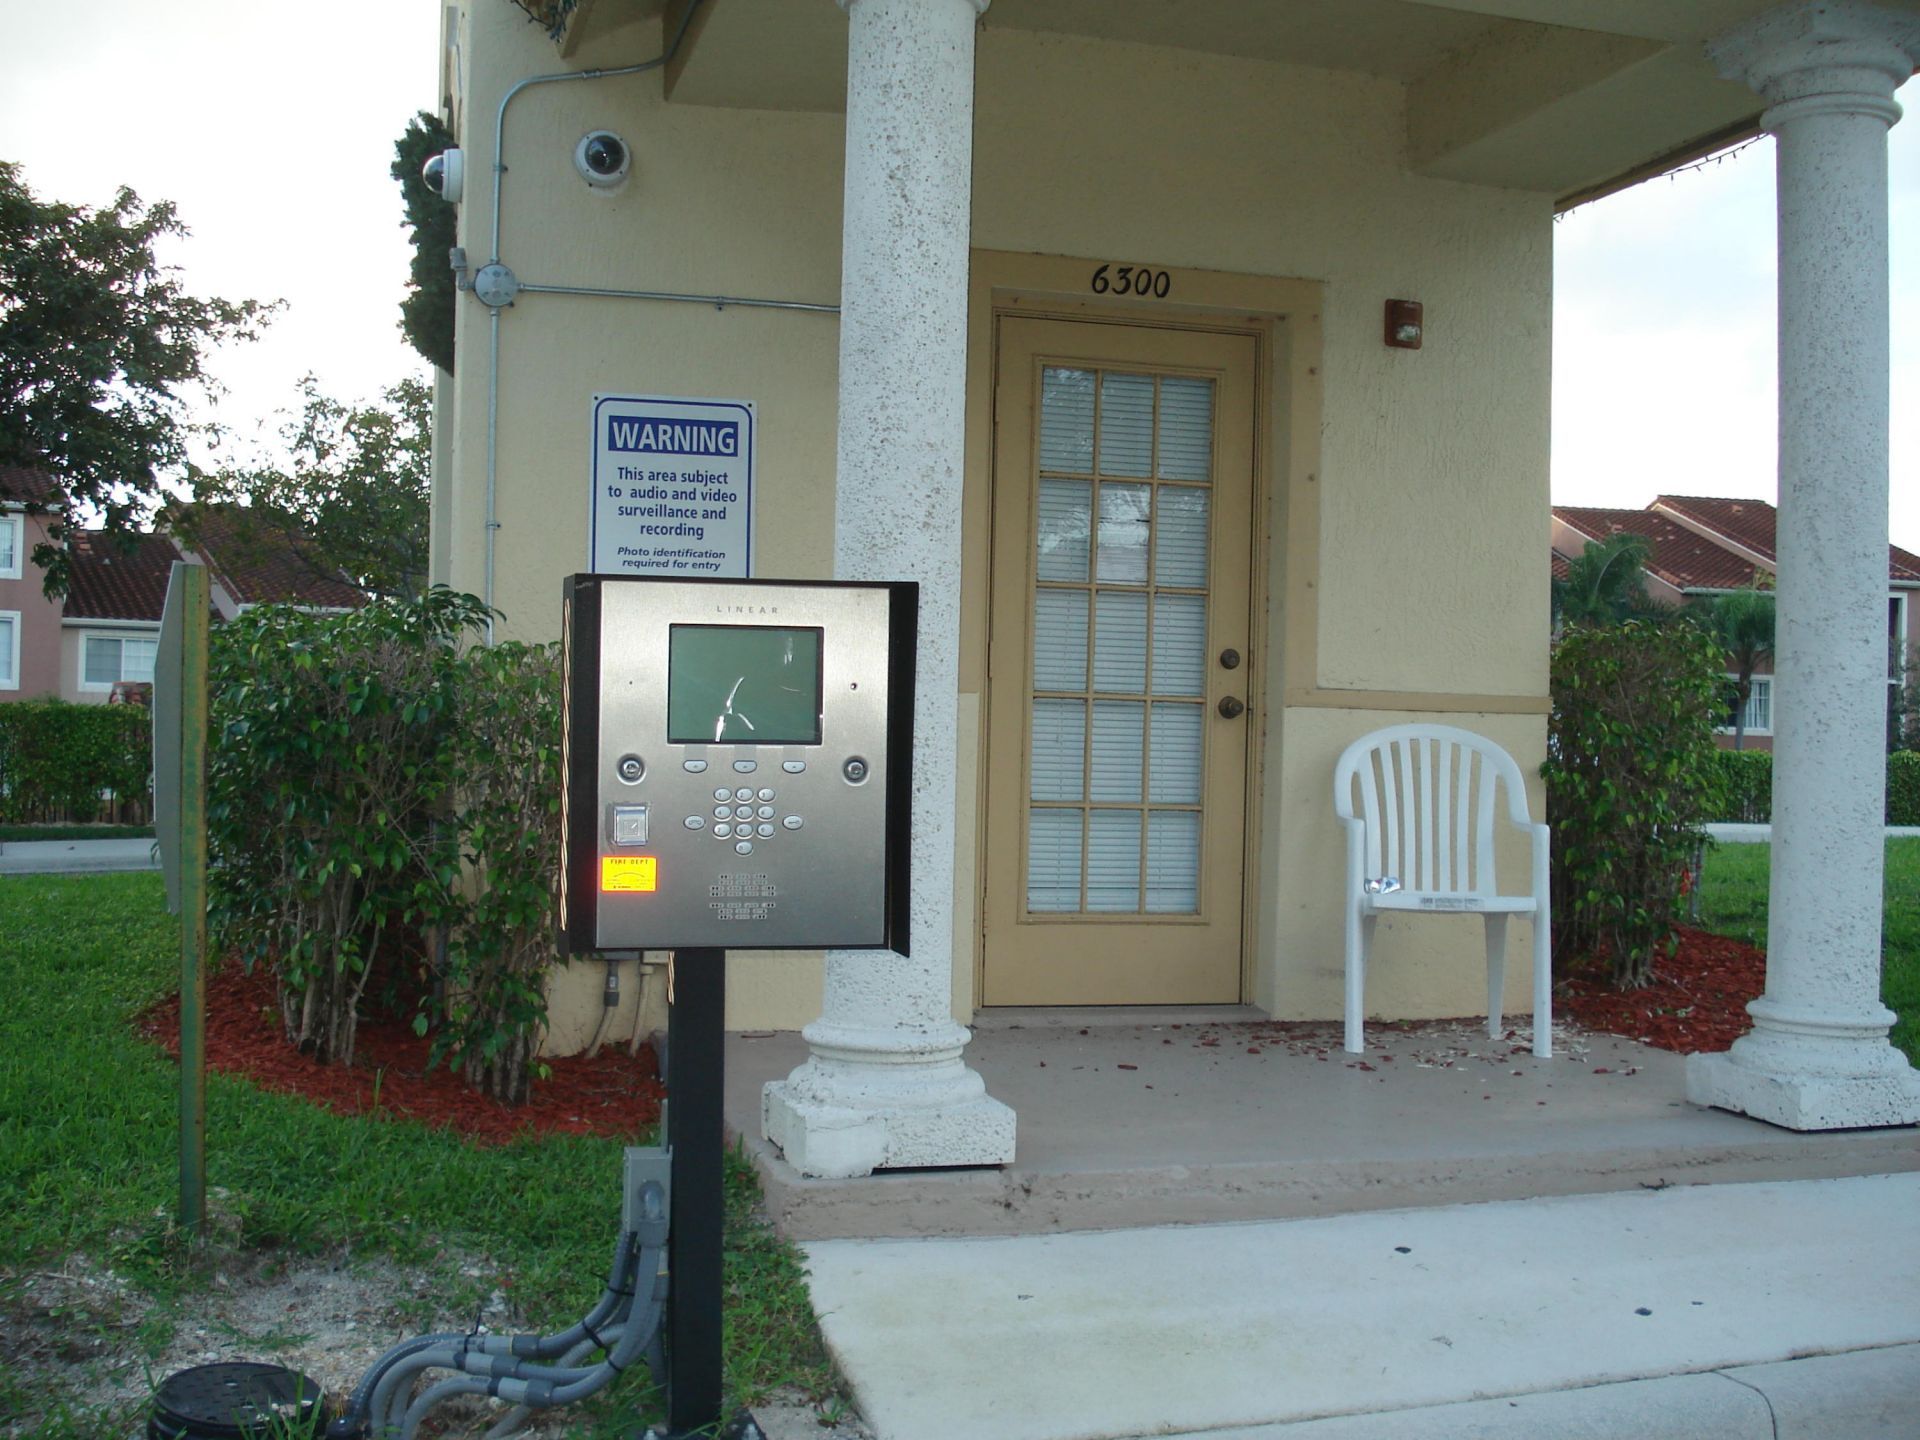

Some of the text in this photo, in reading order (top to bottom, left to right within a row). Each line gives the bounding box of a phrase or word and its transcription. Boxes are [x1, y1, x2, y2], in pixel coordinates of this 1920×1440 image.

[1091, 263, 1170, 298] 6300
[612, 421, 736, 454] WARNING
[617, 466, 729, 487] This area subject
[607, 485, 737, 503] to audio and video
[617, 504, 727, 520] surveillance and
[639, 523, 704, 540] recording
[616, 546, 726, 559] Photo identification
[621, 558, 721, 572] required for entry
[716, 605, 778, 614] LINEAR
